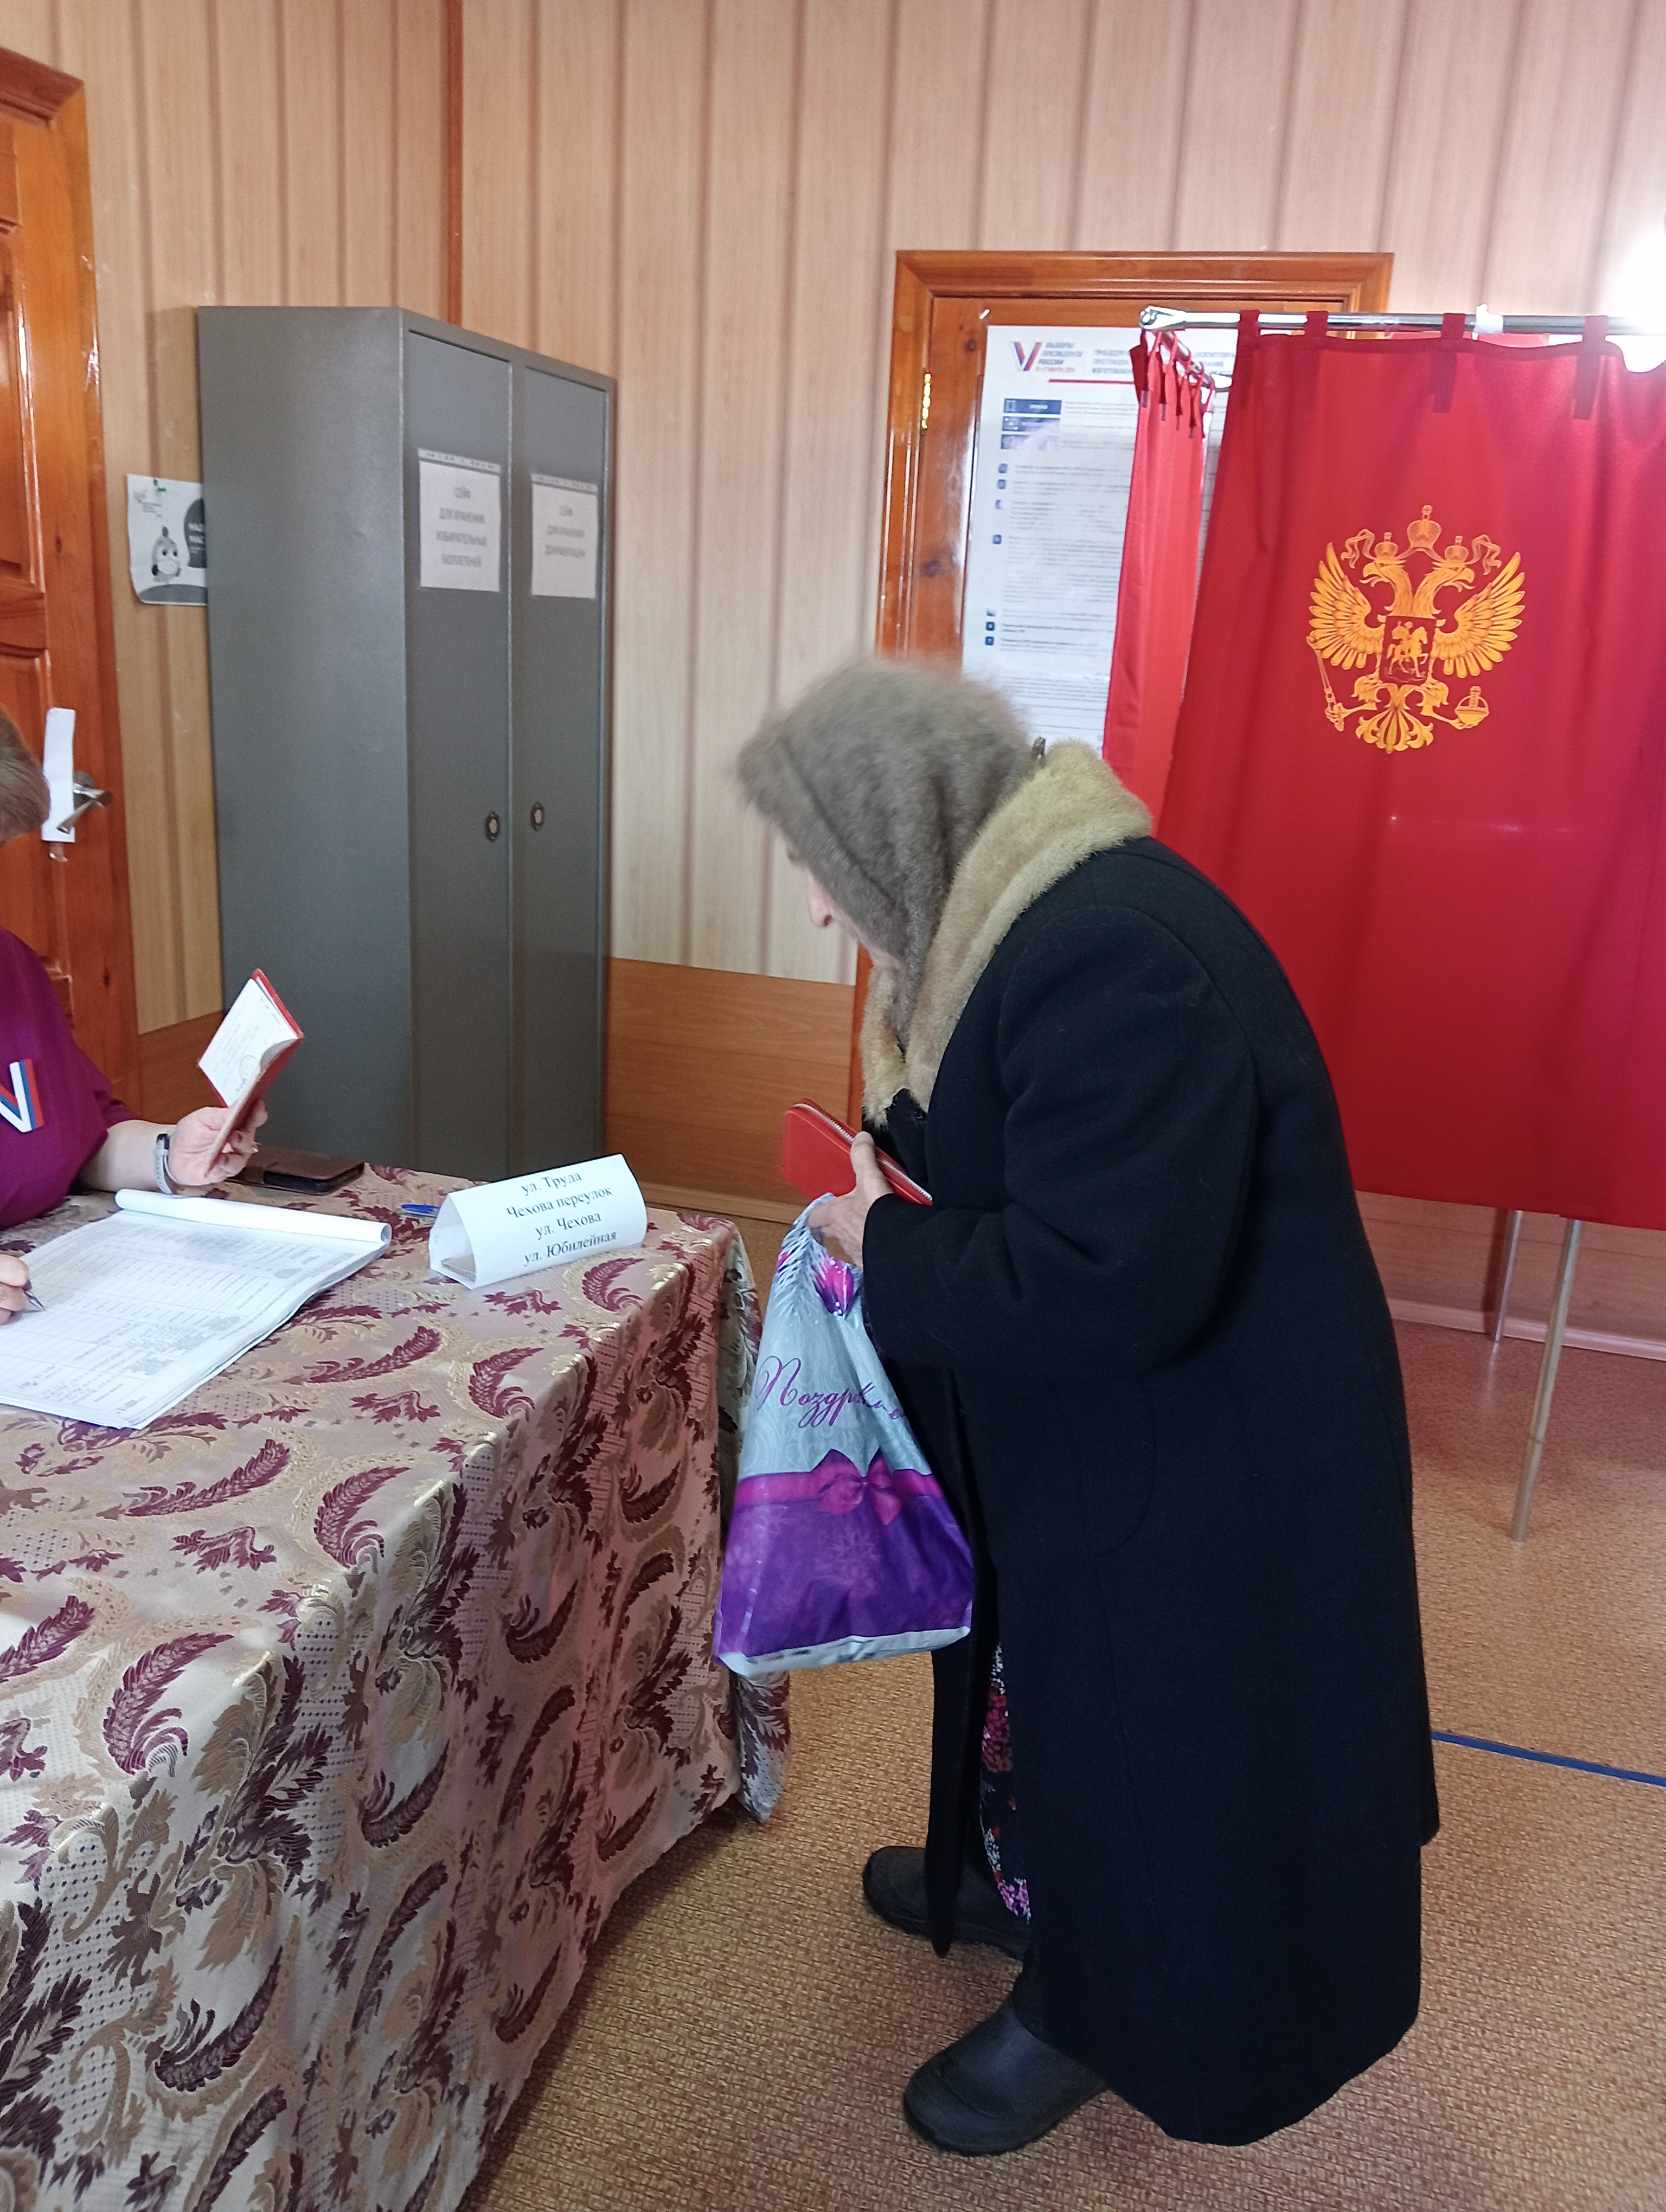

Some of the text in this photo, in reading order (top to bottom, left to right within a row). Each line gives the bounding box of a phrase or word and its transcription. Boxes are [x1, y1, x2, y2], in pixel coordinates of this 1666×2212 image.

[521, 1173, 582, 1196] ул. Труда
[505, 1187, 613, 1218] Чехова переулок
[535, 1213, 601, 1240] ул. Чехова
[523, 1232, 617, 1267] ул. Юбилейная
